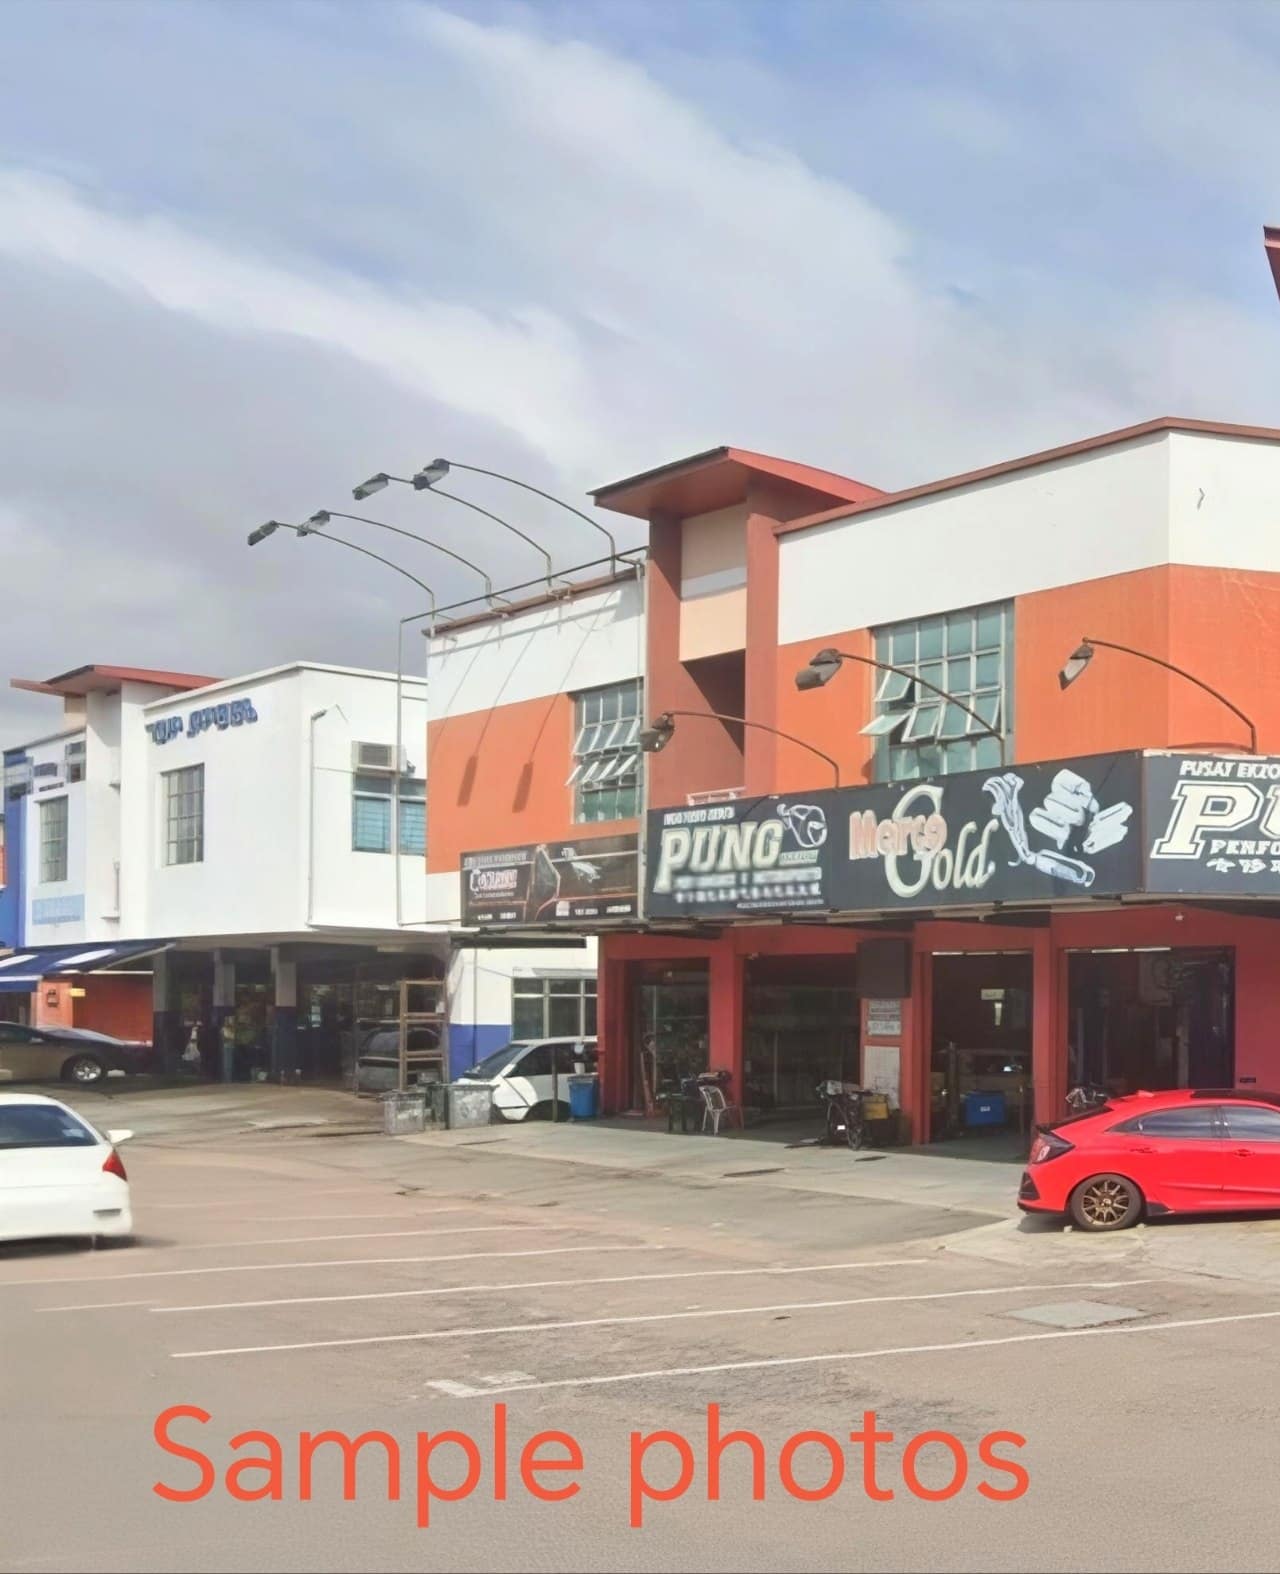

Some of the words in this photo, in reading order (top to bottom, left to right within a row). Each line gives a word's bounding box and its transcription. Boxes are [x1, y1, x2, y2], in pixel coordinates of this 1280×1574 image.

[1179, 760, 1235, 777] PUSAT
[652, 819, 785, 893] PUNG
[885, 784, 999, 898] Gold
